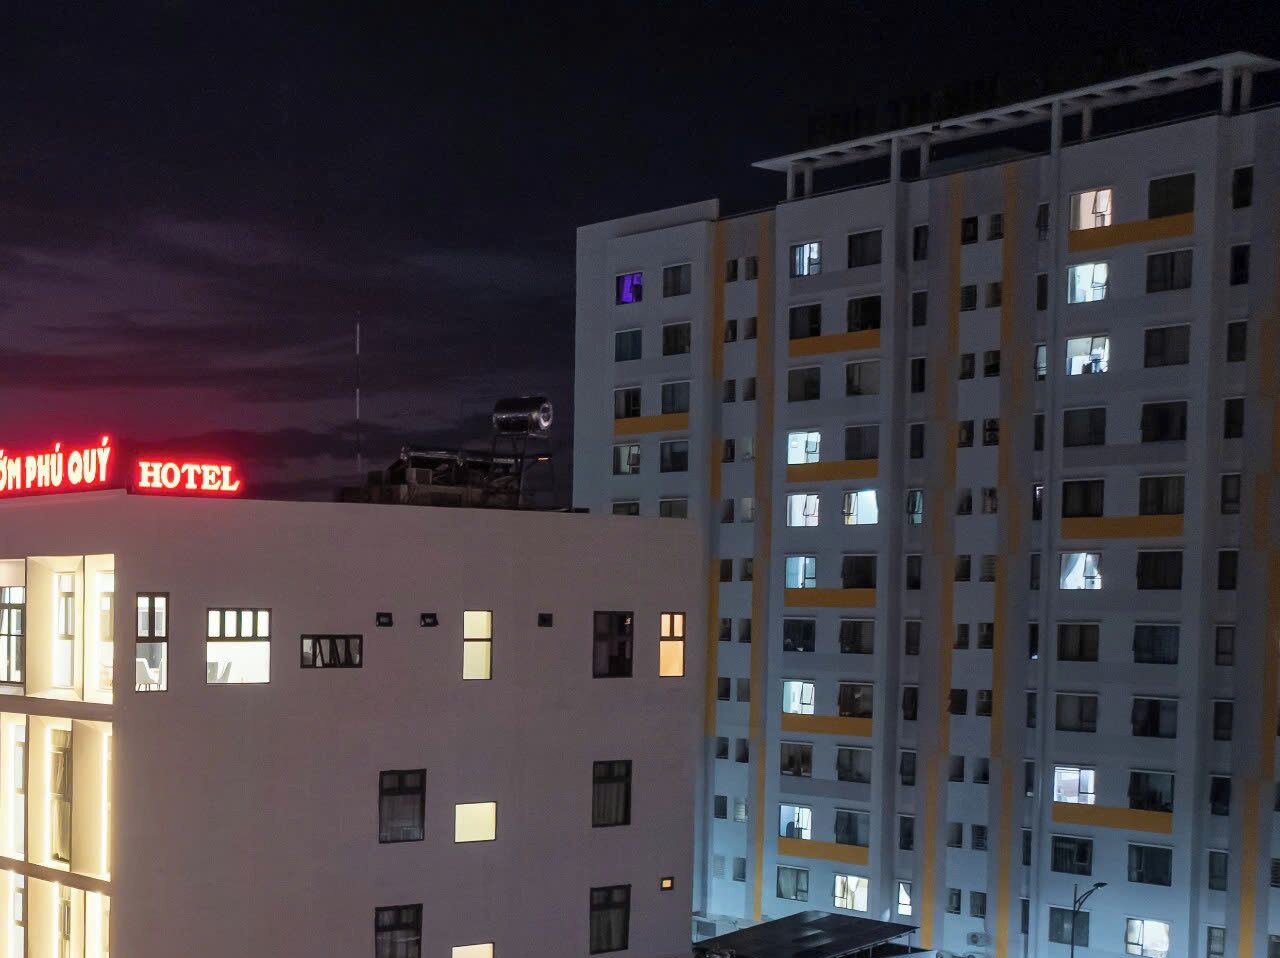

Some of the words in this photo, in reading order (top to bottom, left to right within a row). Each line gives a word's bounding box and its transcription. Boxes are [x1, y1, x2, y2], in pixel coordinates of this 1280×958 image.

[25, 443, 63, 488] PHÚ
[67, 436, 110, 484] QUÝ
[138, 461, 240, 492] HOTEL
